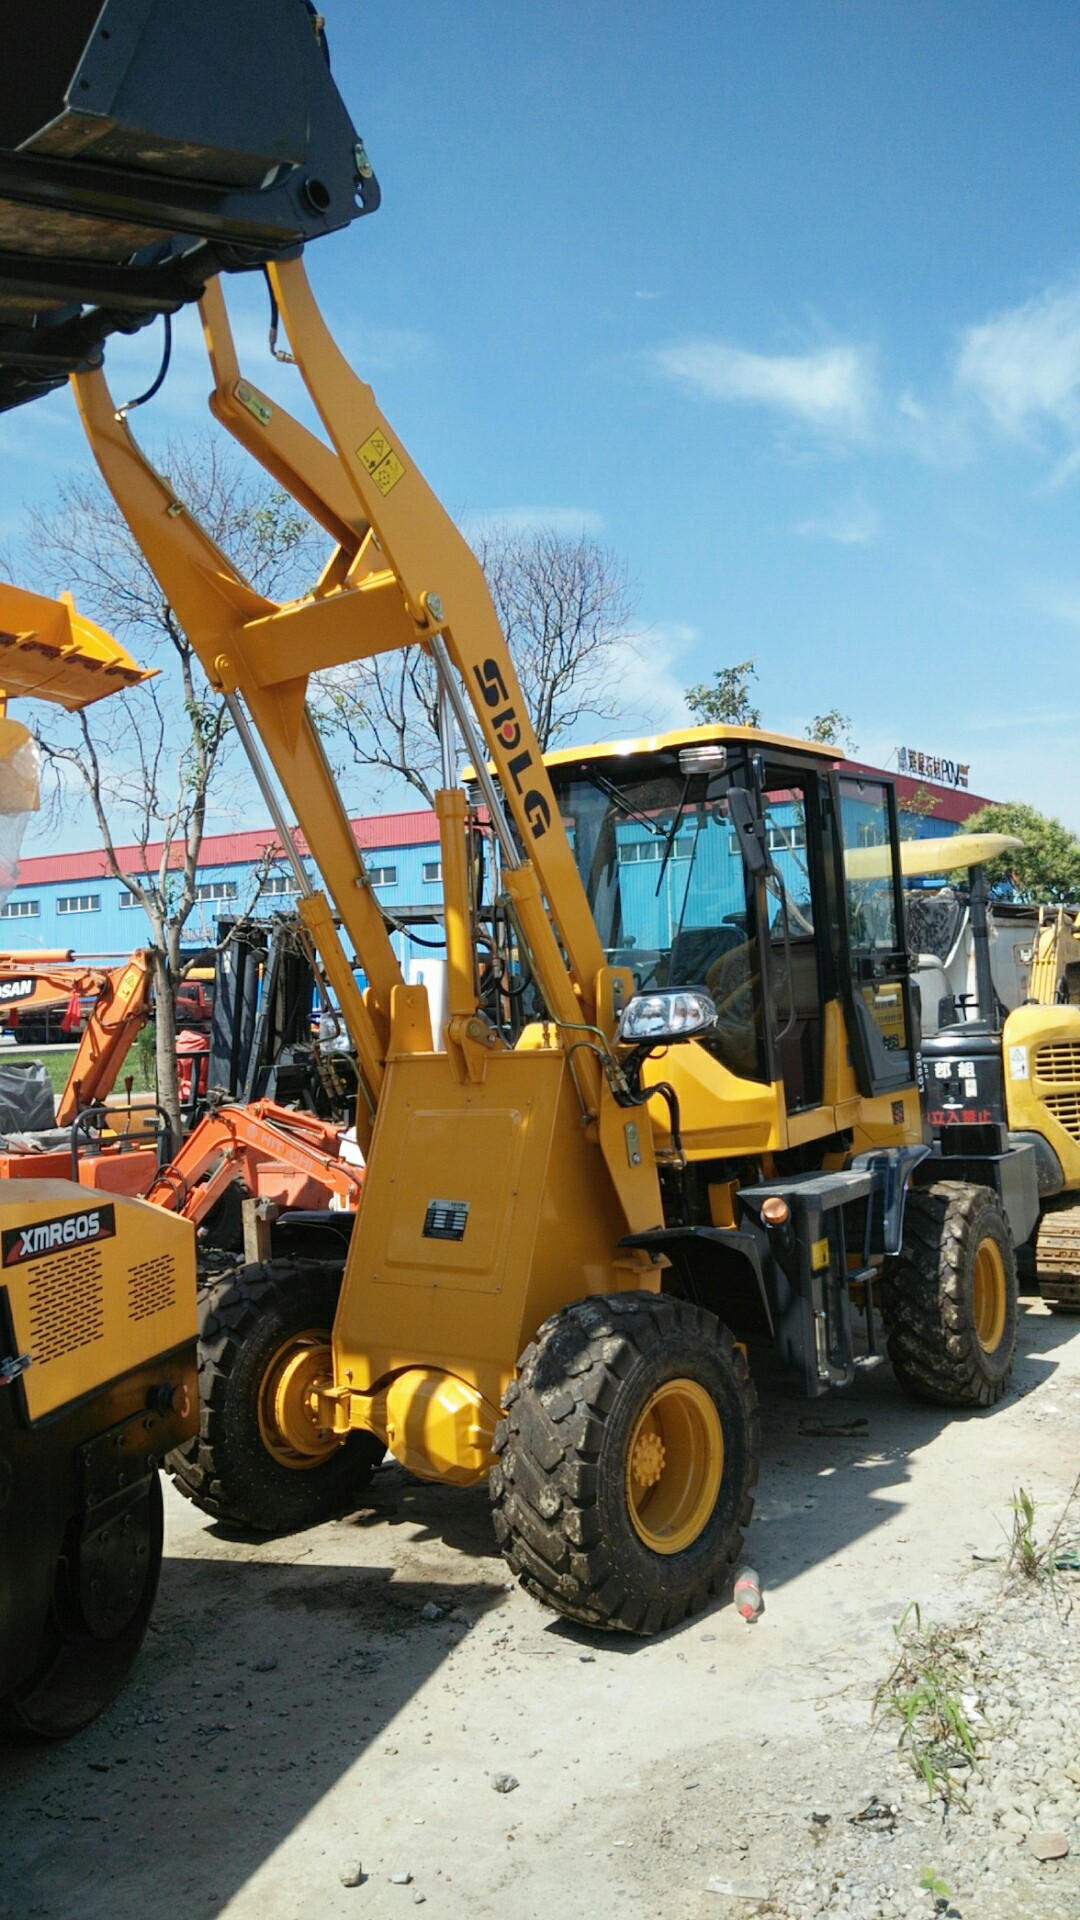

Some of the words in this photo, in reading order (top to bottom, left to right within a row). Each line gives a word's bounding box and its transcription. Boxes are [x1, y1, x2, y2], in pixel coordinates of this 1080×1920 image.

[473, 658, 551, 839] SDLG
[0, 979, 32, 999] SAN
[20, 1211, 100, 1256] XMR60S
